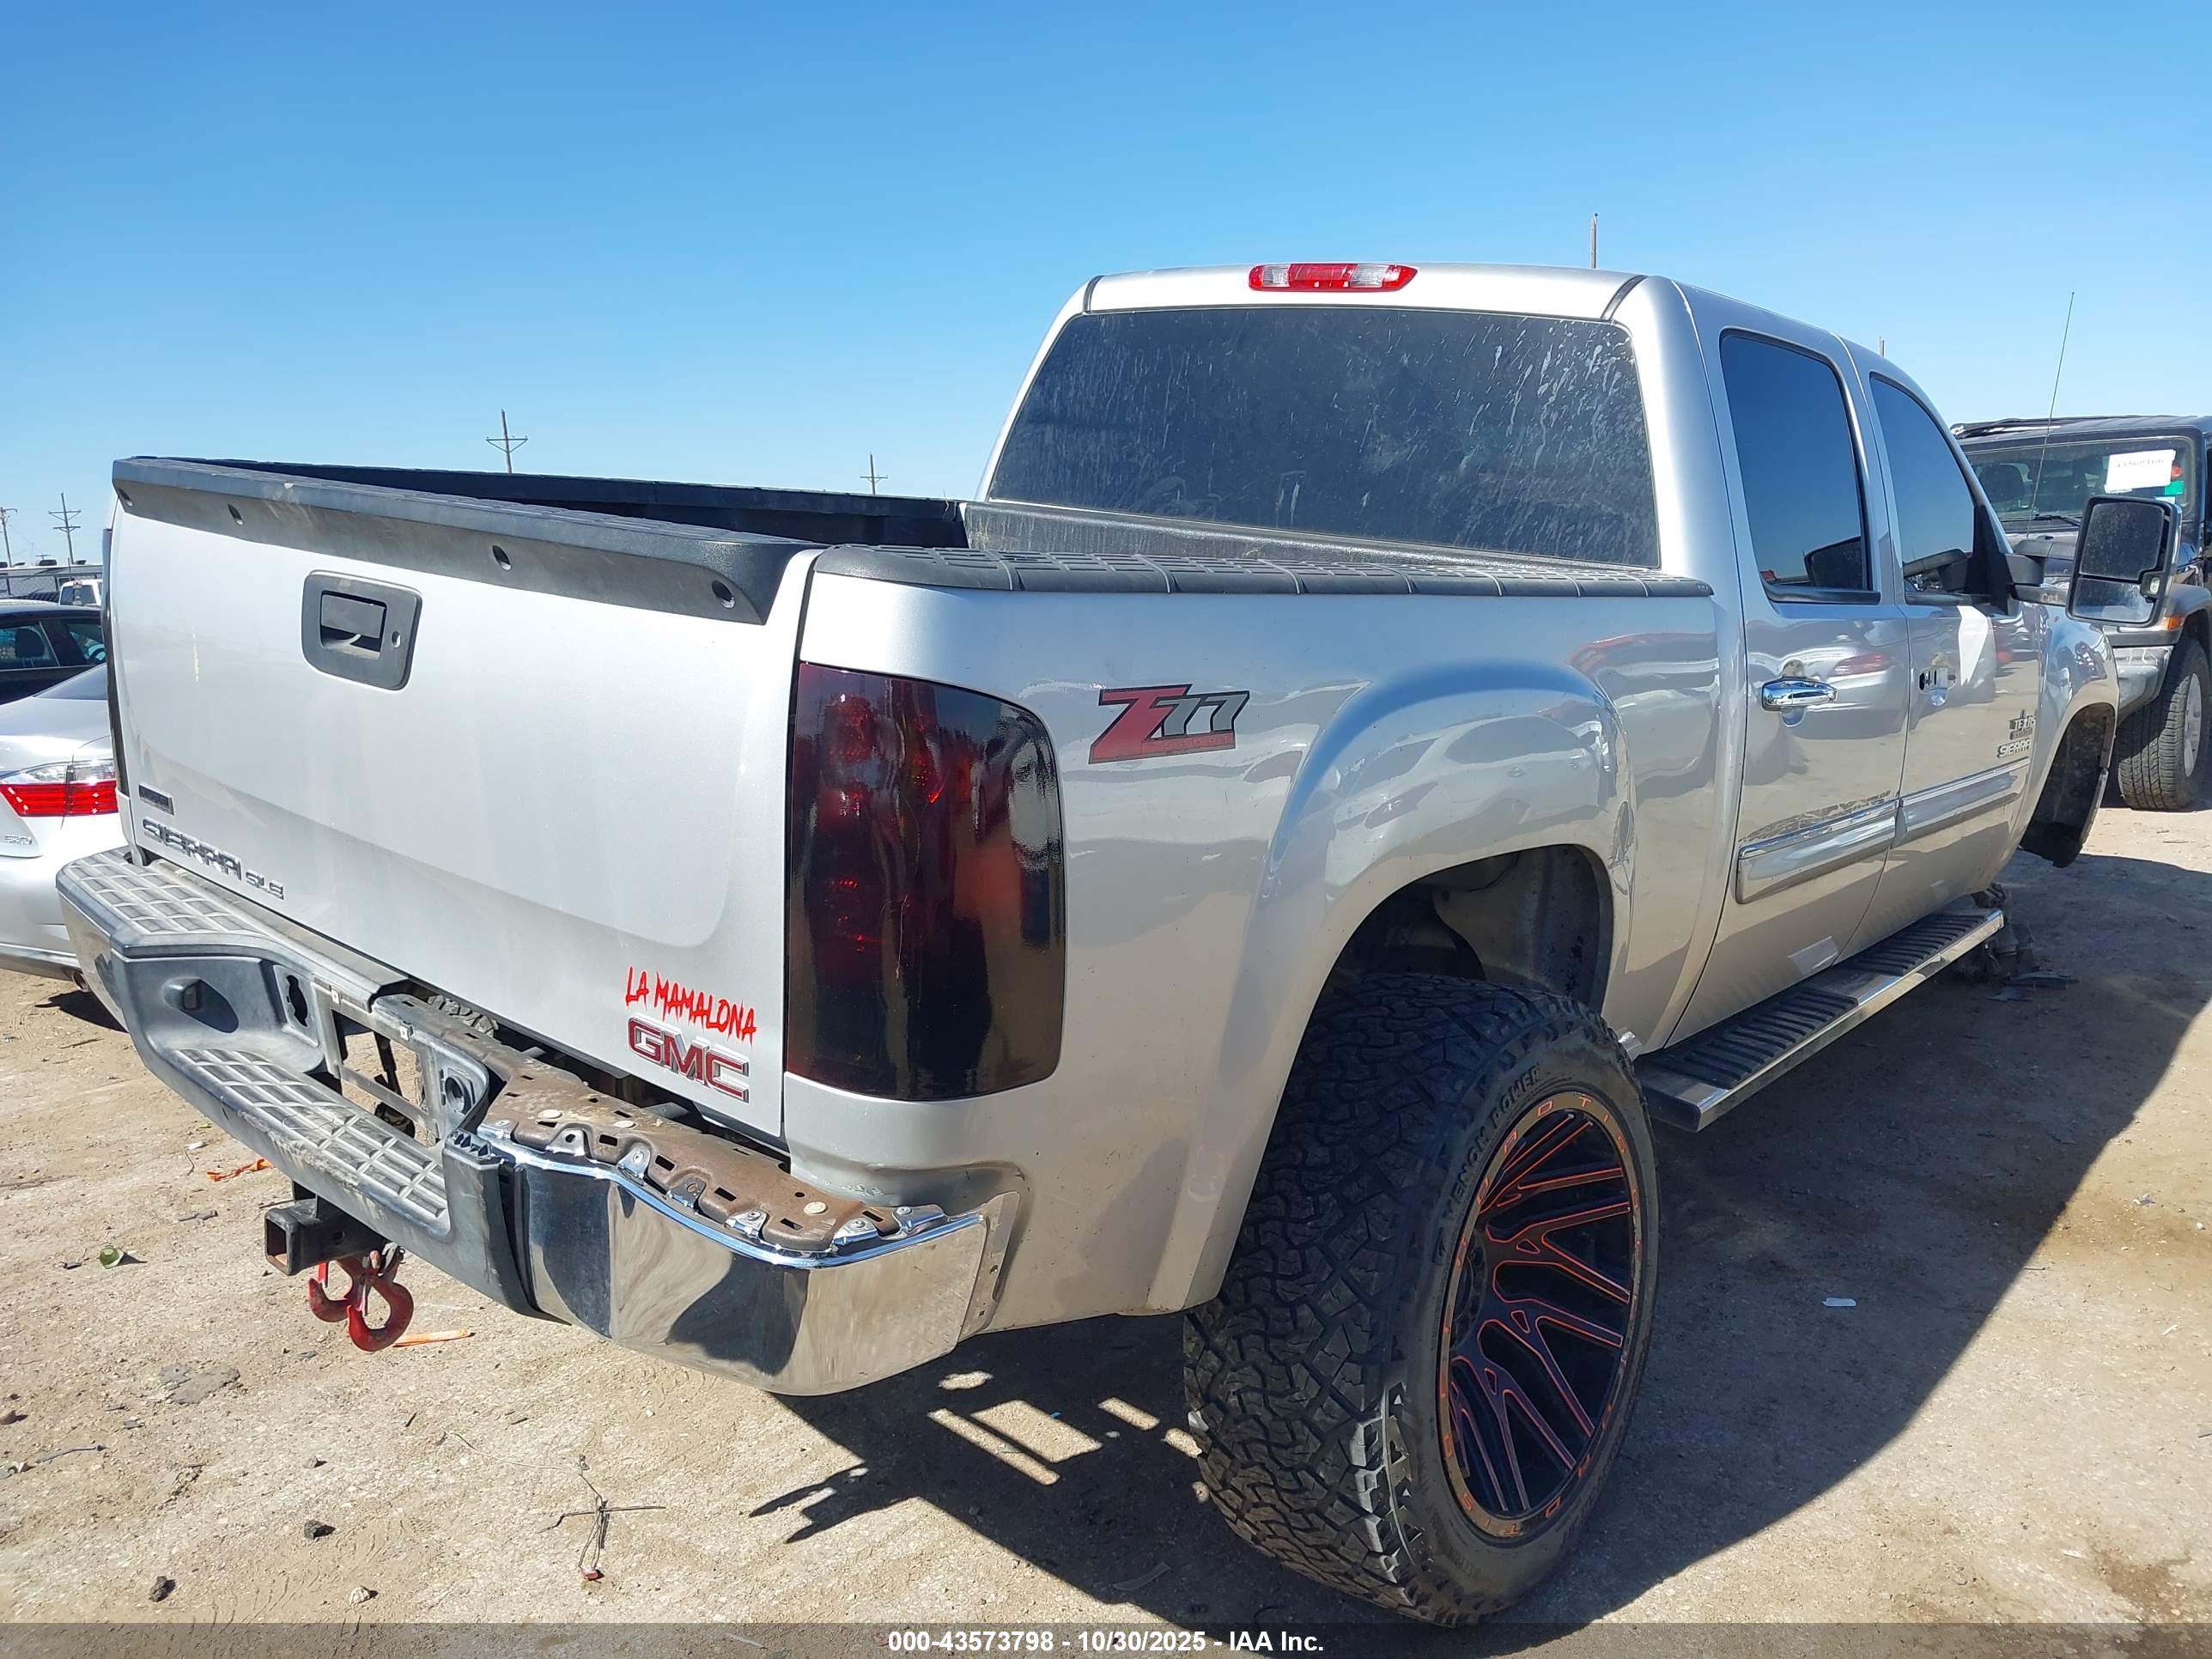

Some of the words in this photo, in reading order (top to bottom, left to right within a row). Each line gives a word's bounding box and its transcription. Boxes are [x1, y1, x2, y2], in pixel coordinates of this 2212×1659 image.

[143, 817, 243, 880] SIERRA
[624, 963, 650, 1011] LA
[653, 970, 761, 1049] MAMALONA
[628, 1012, 750, 1105] GMC
